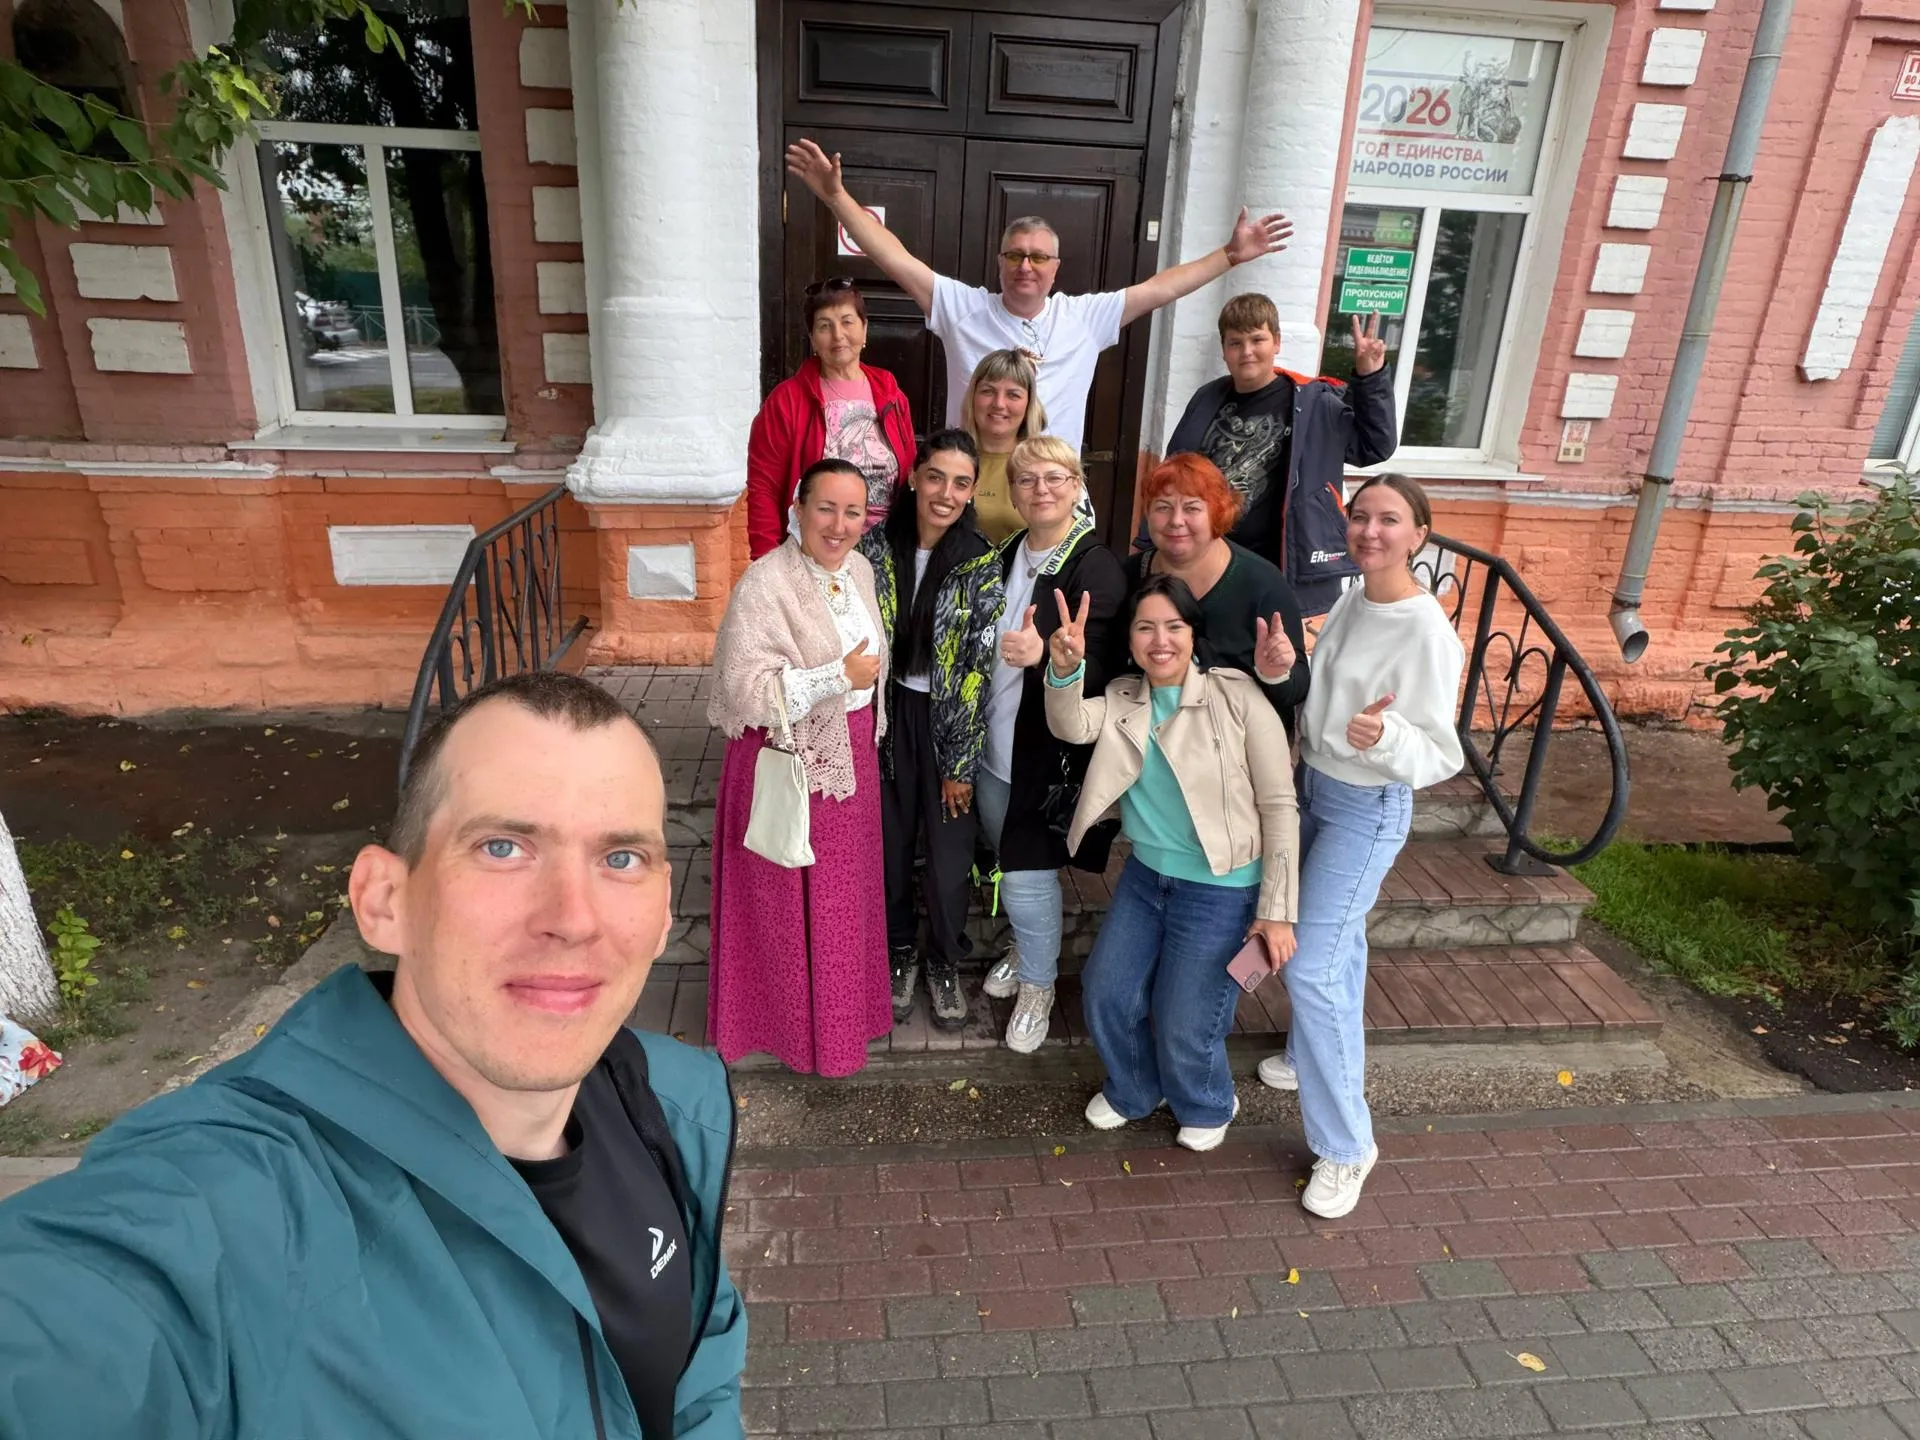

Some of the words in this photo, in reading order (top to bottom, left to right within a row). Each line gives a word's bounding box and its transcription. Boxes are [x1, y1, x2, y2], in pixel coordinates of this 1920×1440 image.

[1359, 83, 1452, 126] 2026
[1355, 141, 1389, 158] ГОД
[1395, 143, 1484, 162] ЕДИНСТВА
[1353, 159, 1436, 178] НАРОДОВ
[1440, 165, 1508, 183] РОССИИ
[1345, 288, 1403, 299] ПРОПУСКНОЙ
[1356, 299, 1389, 309] РЕЖИМ
[1055, 525, 1083, 559] FASHION
[650, 1238, 677, 1280] DEMIX
